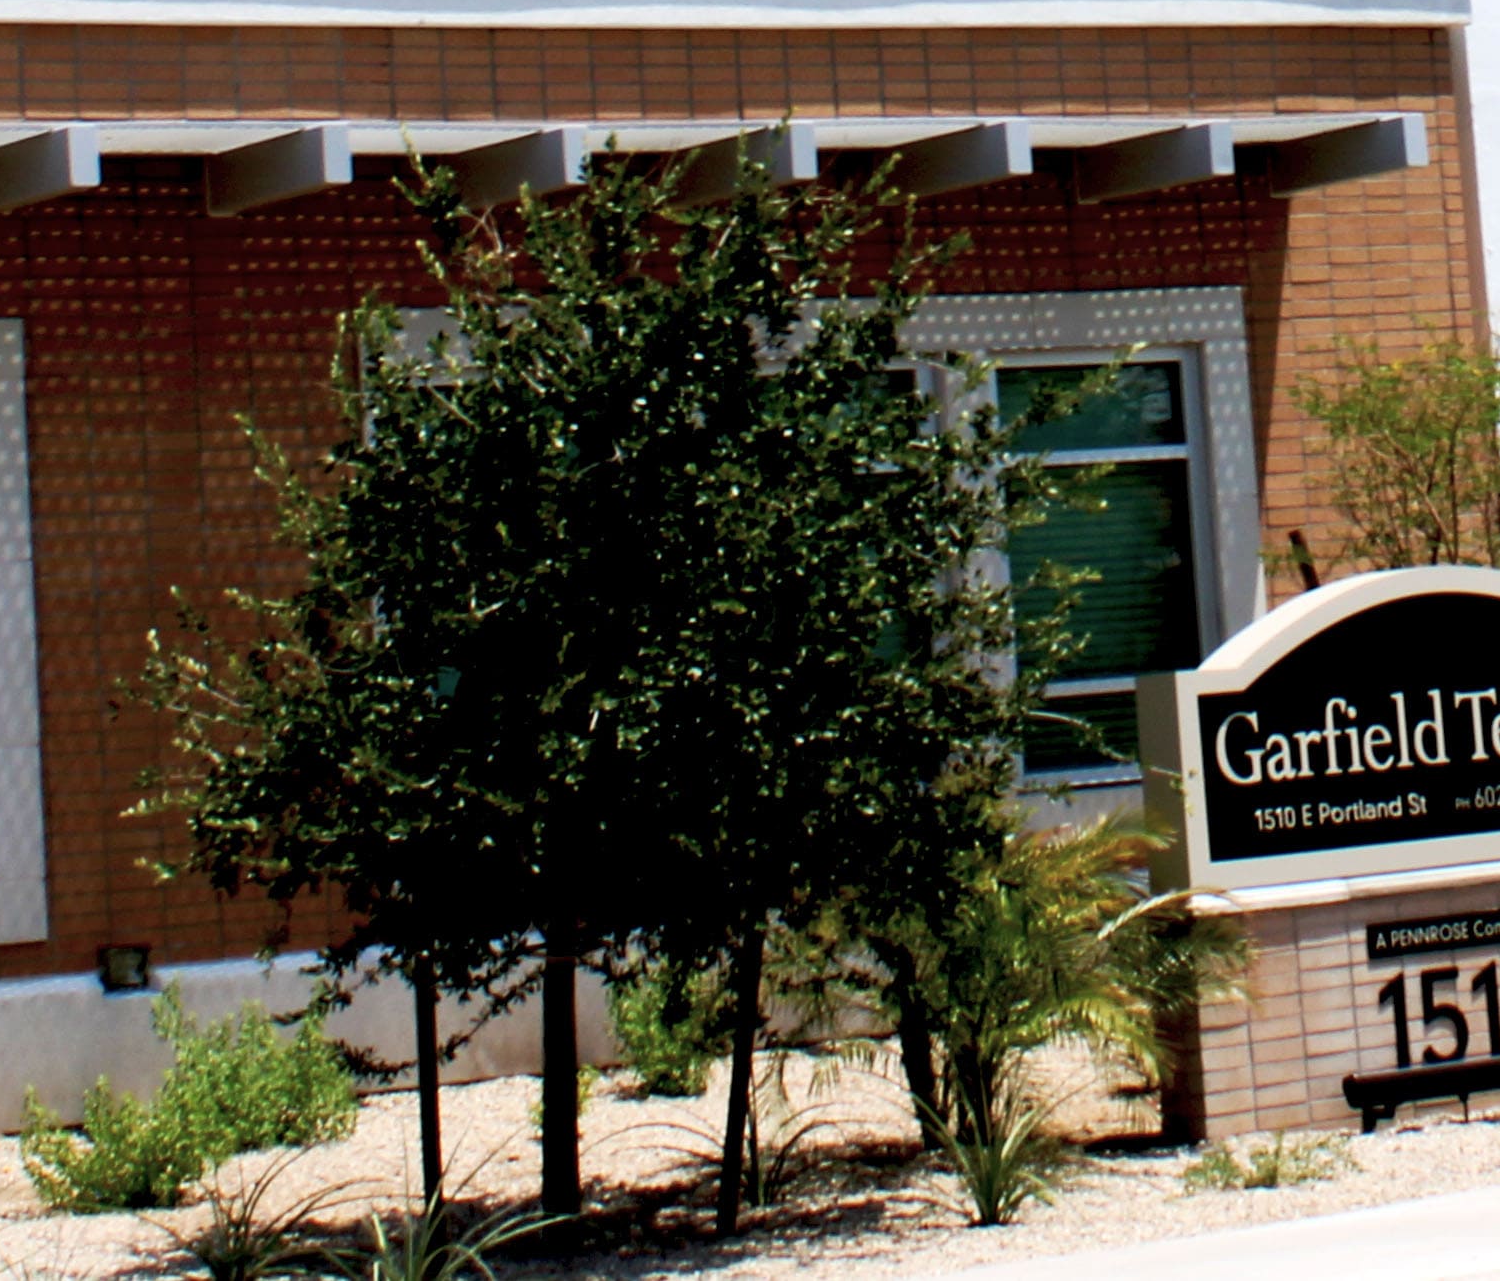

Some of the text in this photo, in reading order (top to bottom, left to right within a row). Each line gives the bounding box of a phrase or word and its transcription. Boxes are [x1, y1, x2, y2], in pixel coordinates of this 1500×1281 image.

[1215, 688, 1451, 784] Garfield
[1254, 791, 1428, 831] 1510 E Portland St
[1375, 932, 1387, 949] A
[1390, 920, 1469, 948] PENNROSE
